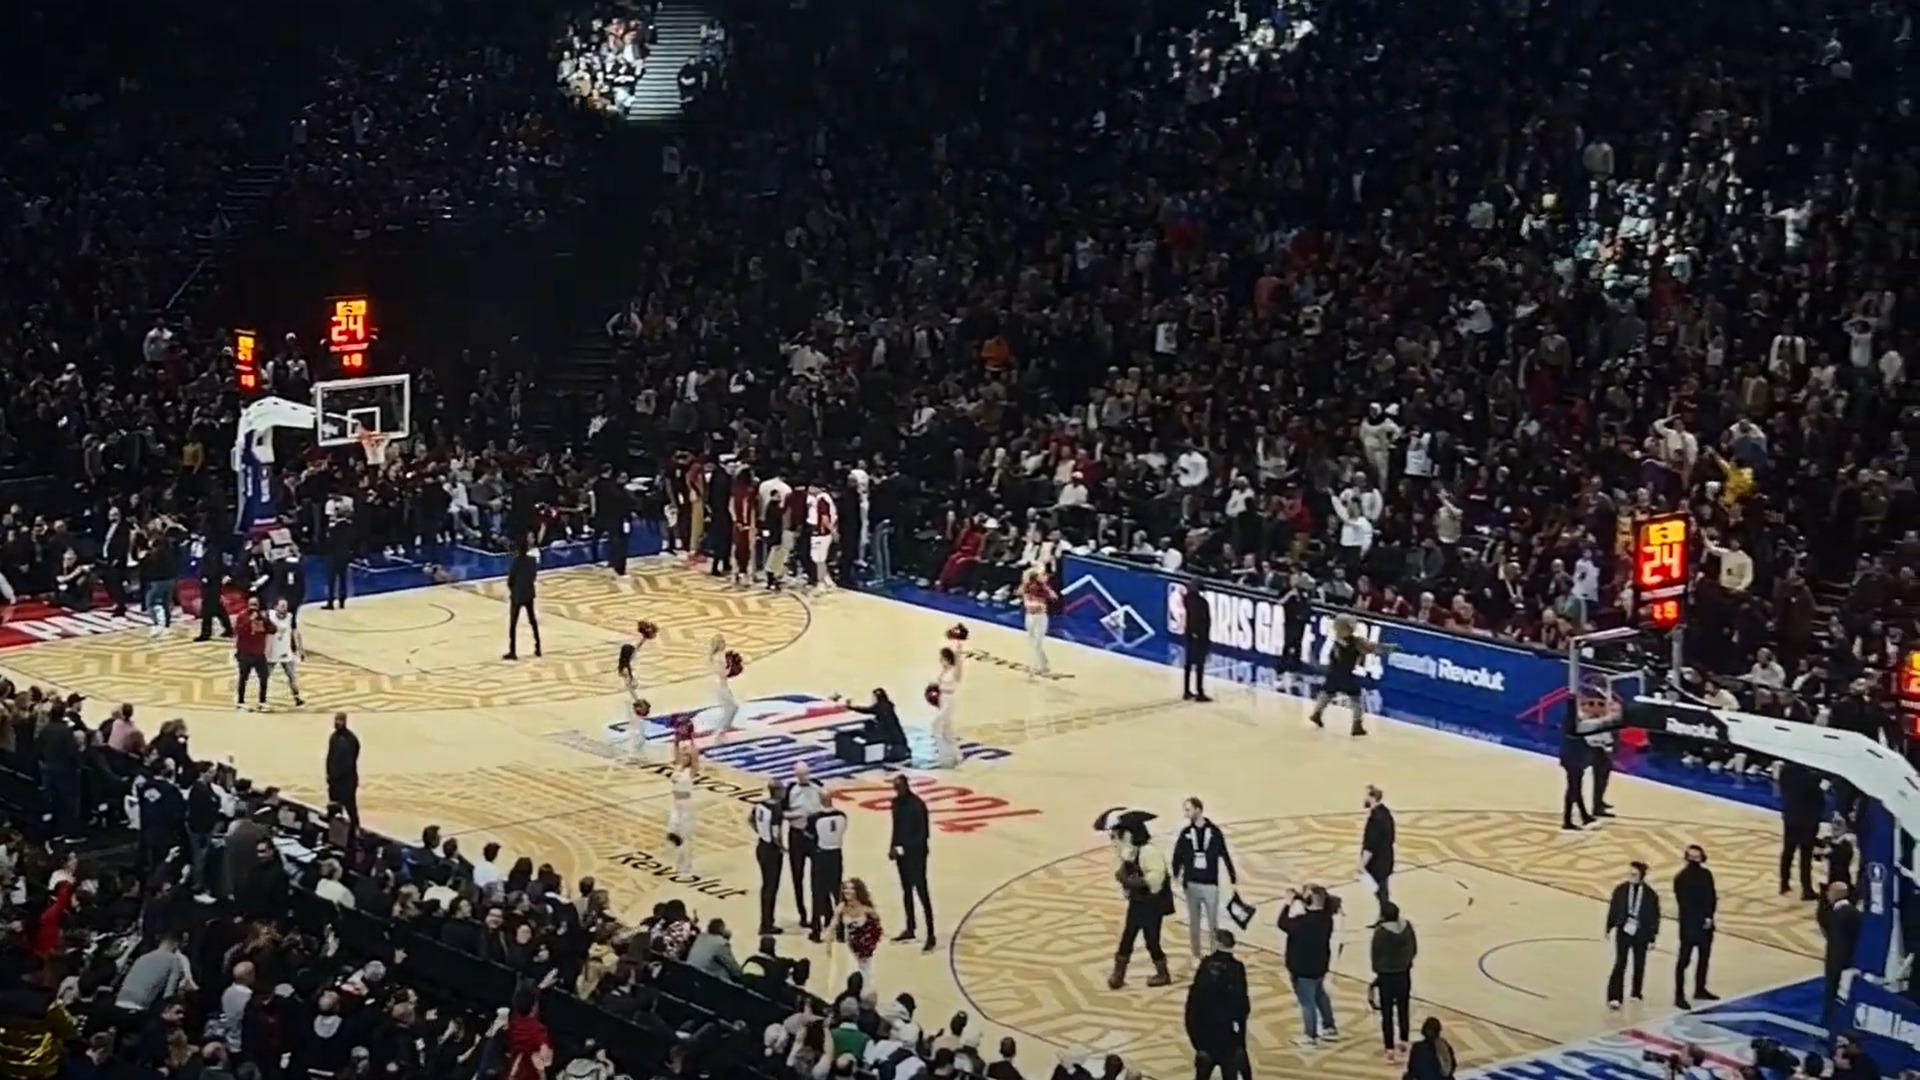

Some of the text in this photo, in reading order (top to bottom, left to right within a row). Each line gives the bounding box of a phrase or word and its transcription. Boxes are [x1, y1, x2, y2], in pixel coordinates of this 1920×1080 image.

[331, 316, 365, 341] 24
[1642, 544, 1681, 584] 24
[1438, 658, 1505, 691] Revolut
[610, 851, 748, 900] Revolut
